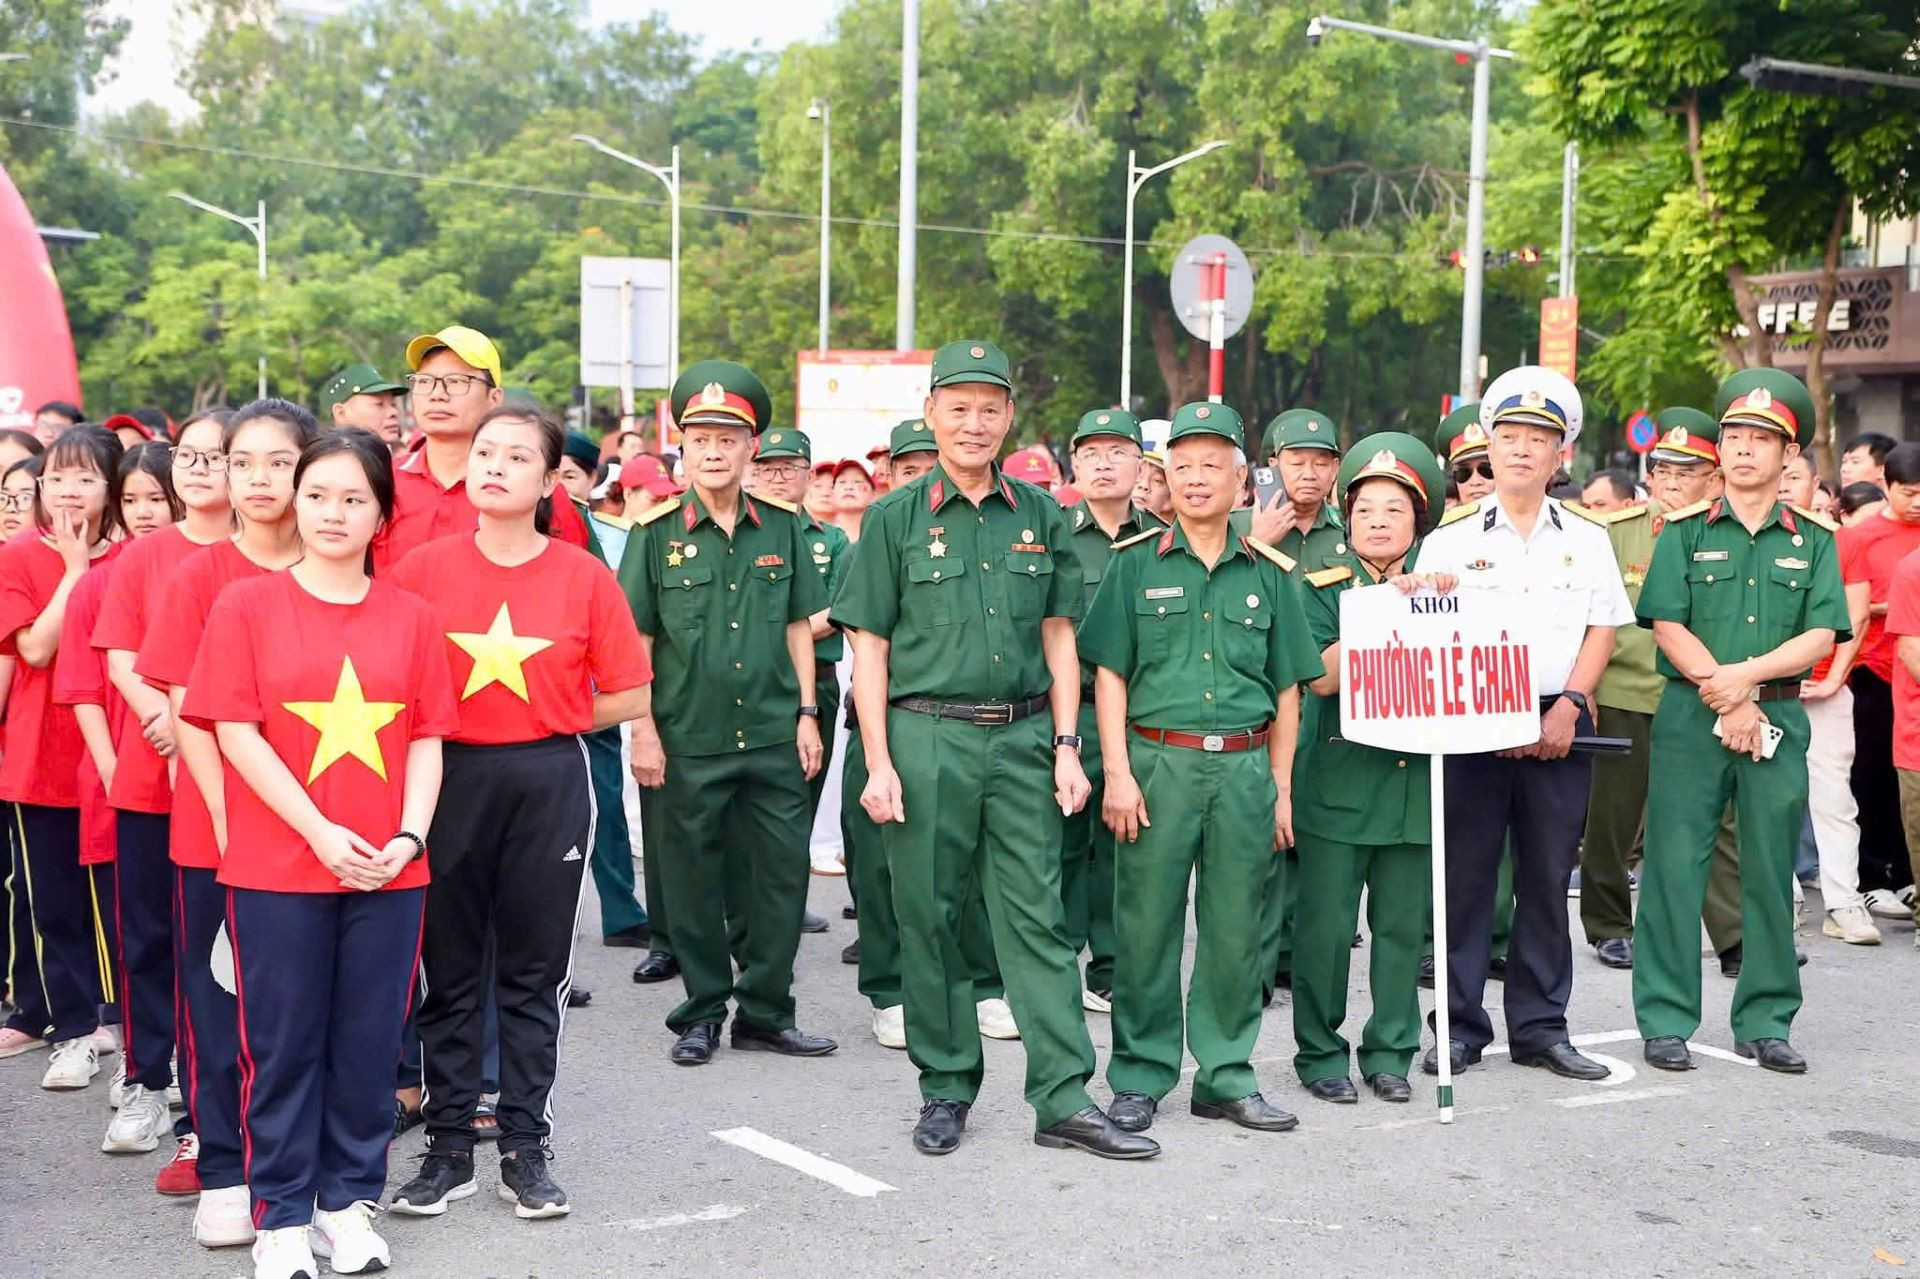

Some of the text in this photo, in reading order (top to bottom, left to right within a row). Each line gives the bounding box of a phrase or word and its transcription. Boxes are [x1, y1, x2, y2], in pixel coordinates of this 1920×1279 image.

[1348, 630, 1532, 720] PHƯỜNG LÊ CHÂN
